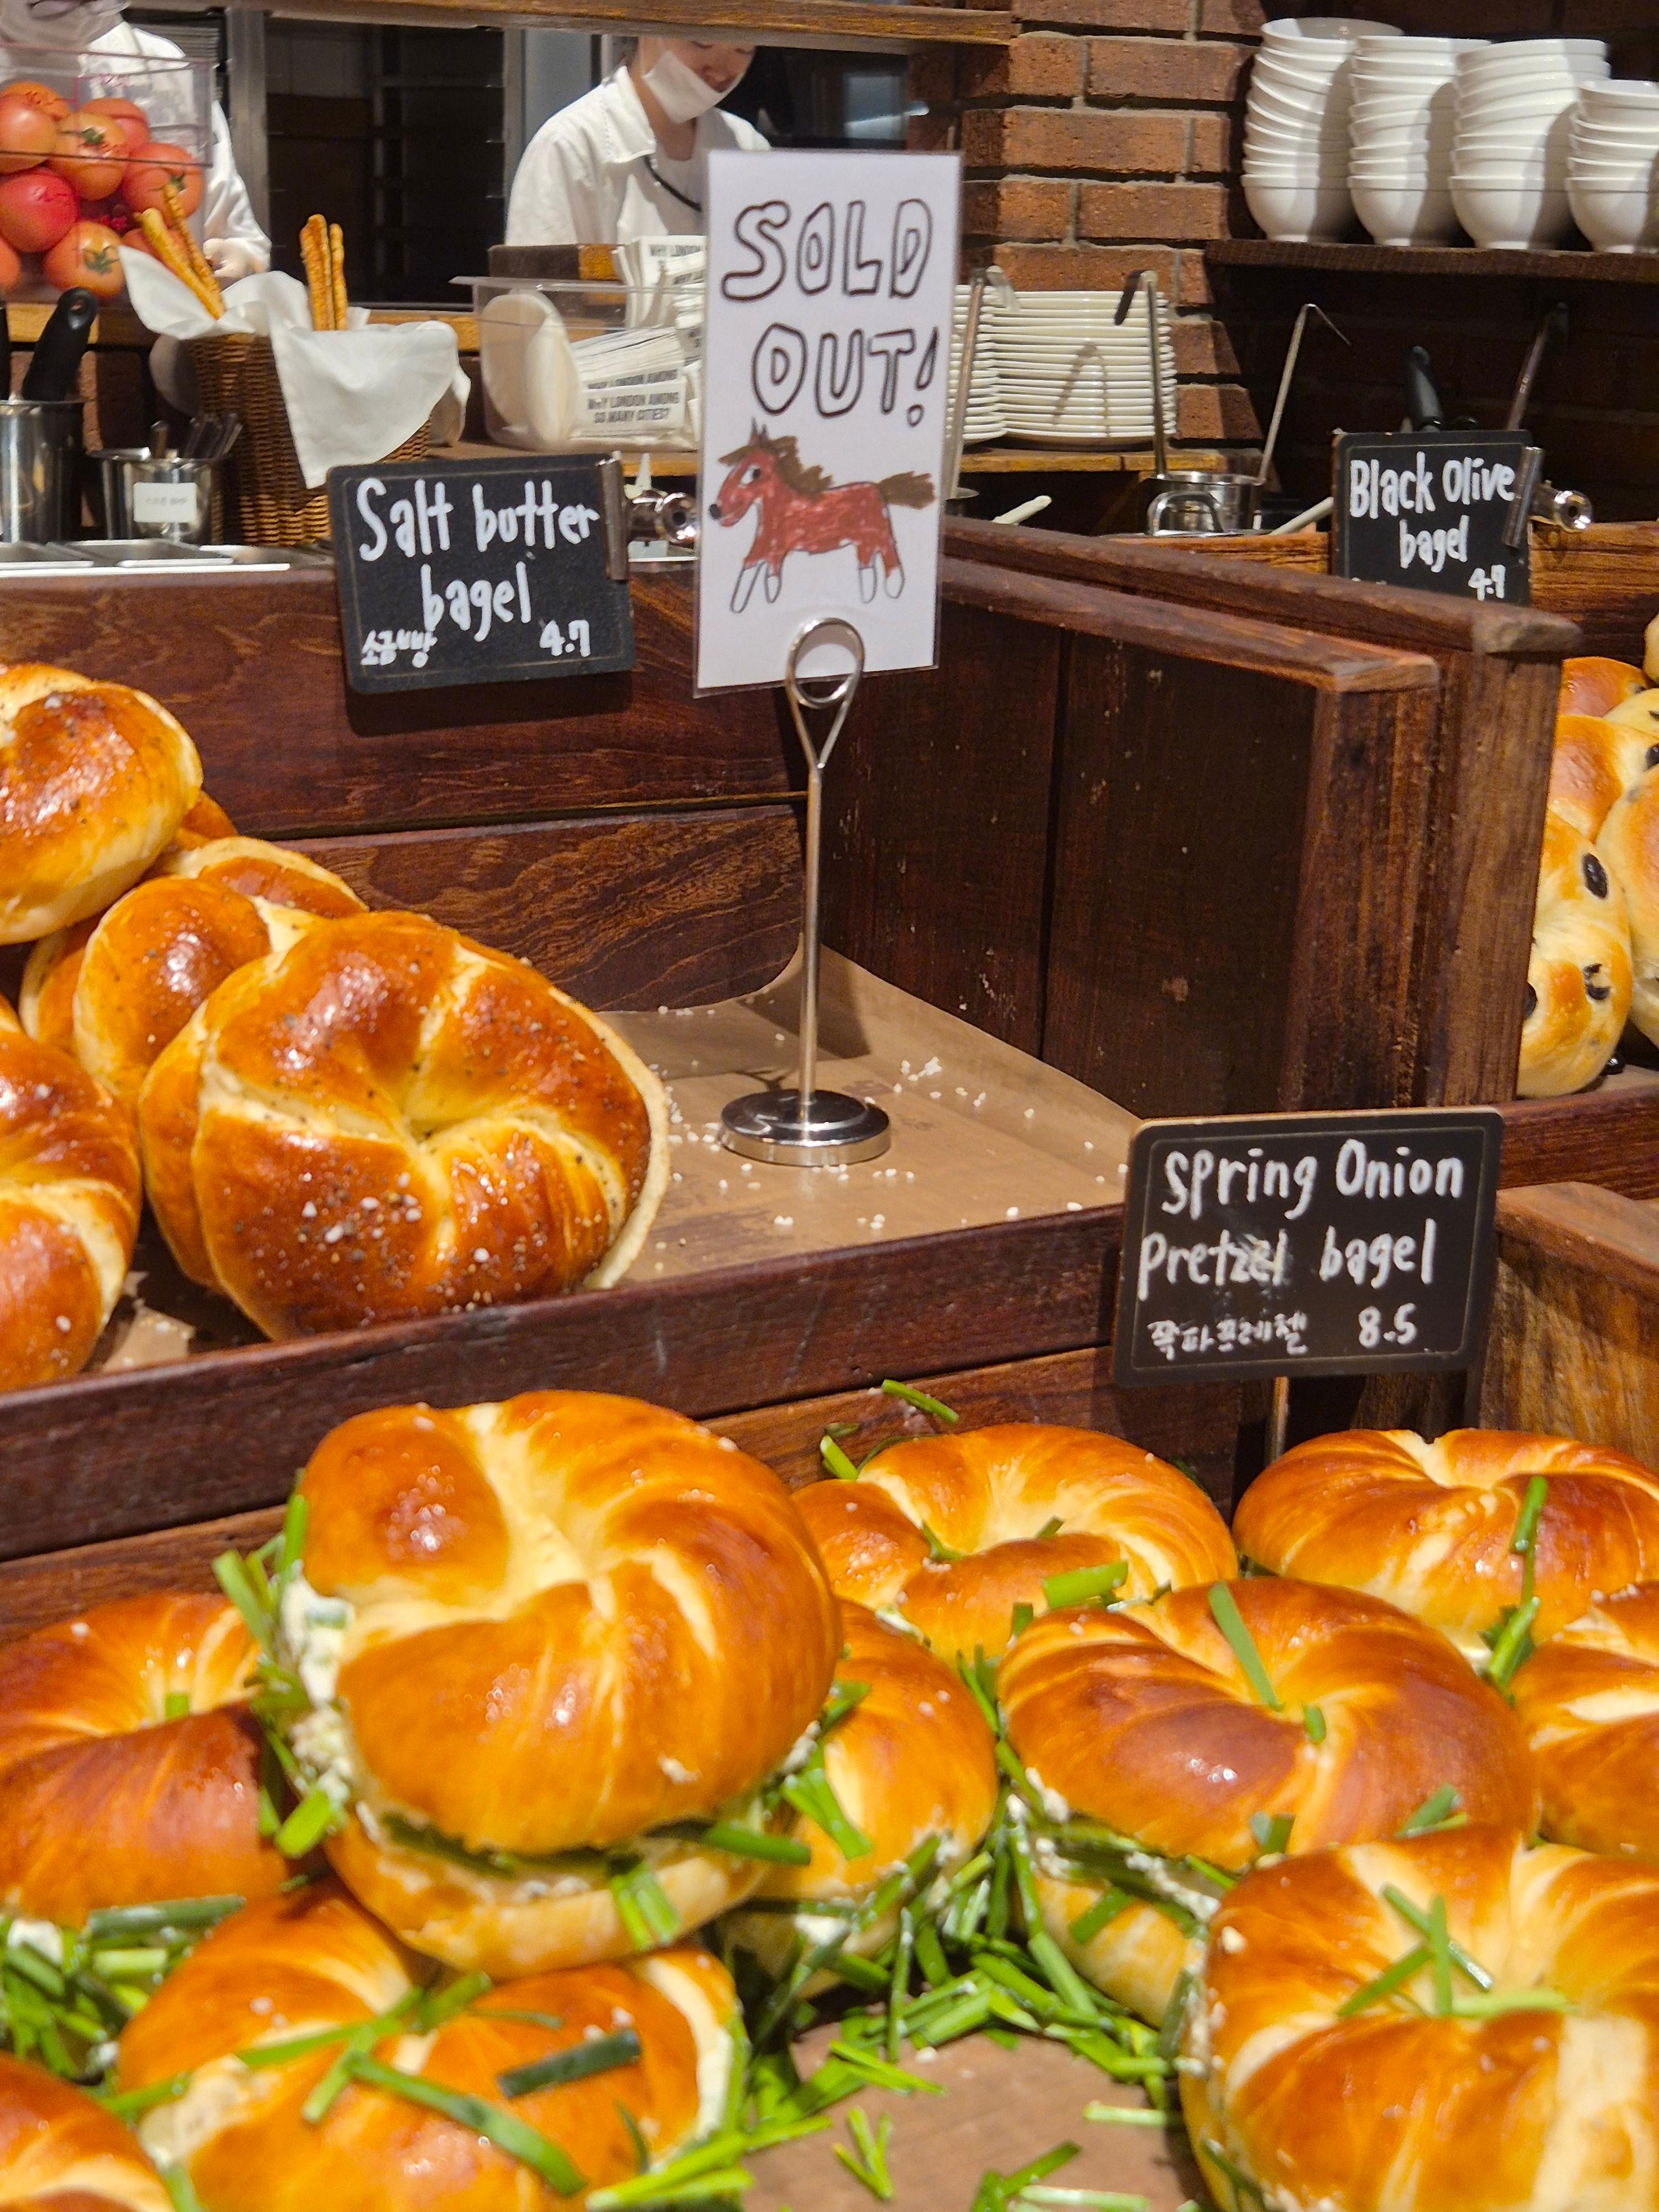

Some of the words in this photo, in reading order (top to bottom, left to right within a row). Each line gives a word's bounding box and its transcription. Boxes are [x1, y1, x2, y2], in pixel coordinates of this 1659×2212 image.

[721, 197, 934, 304] SOLD
[751, 322, 940, 428] OUT!
[357, 477, 454, 561] Salt
[472, 479, 600, 552] butter
[1349, 451, 1436, 519] Black
[1442, 456, 1516, 505] Olive
[1399, 515, 1470, 573] bagel
[420, 561, 531, 643] bagel
[361, 629, 438, 668] 소금빵
[540, 619, 591, 657] 4.7
[1335, 1138, 1463, 1199] Onion
[1319, 1218, 1436, 1289] bagel
[1358, 1302, 1417, 1349] 8.5
